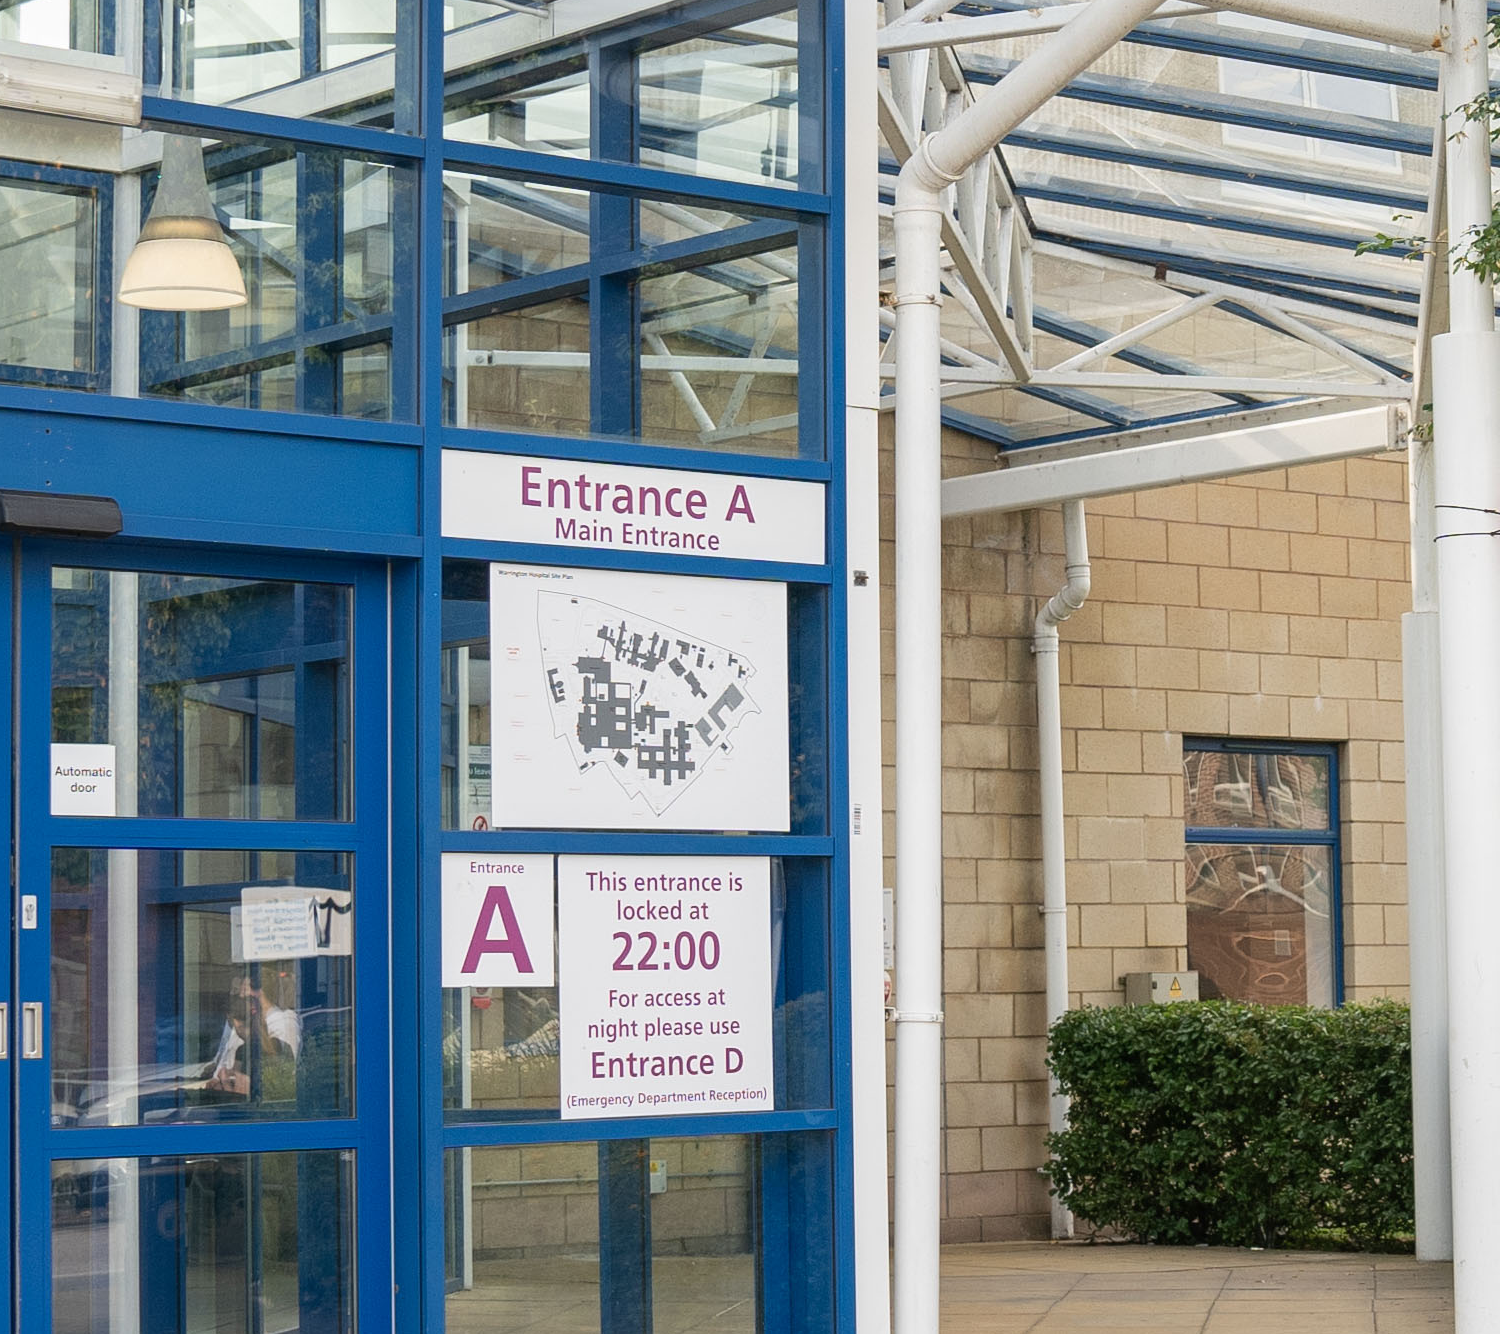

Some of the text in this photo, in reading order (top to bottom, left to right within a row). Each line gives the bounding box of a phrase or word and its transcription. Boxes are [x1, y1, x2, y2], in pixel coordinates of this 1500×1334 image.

[520, 465, 757, 524] Entrance A
[554, 516, 721, 551] Main Entrance
[54, 764, 113, 779] Automatic
[70, 781, 97, 794] door
[469, 861, 525, 875] Entrance
[585, 871, 743, 892] This entrance is
[616, 899, 709, 921] locked at
[460, 885, 535, 974] A
[611, 930, 721, 972] 22:00
[608, 989, 726, 1008] For access at
[587, 1016, 741, 1042] night please use
[590, 1046, 744, 1079] Entrance D
[566, 1087, 767, 1109] (Emergency Department Reception)
